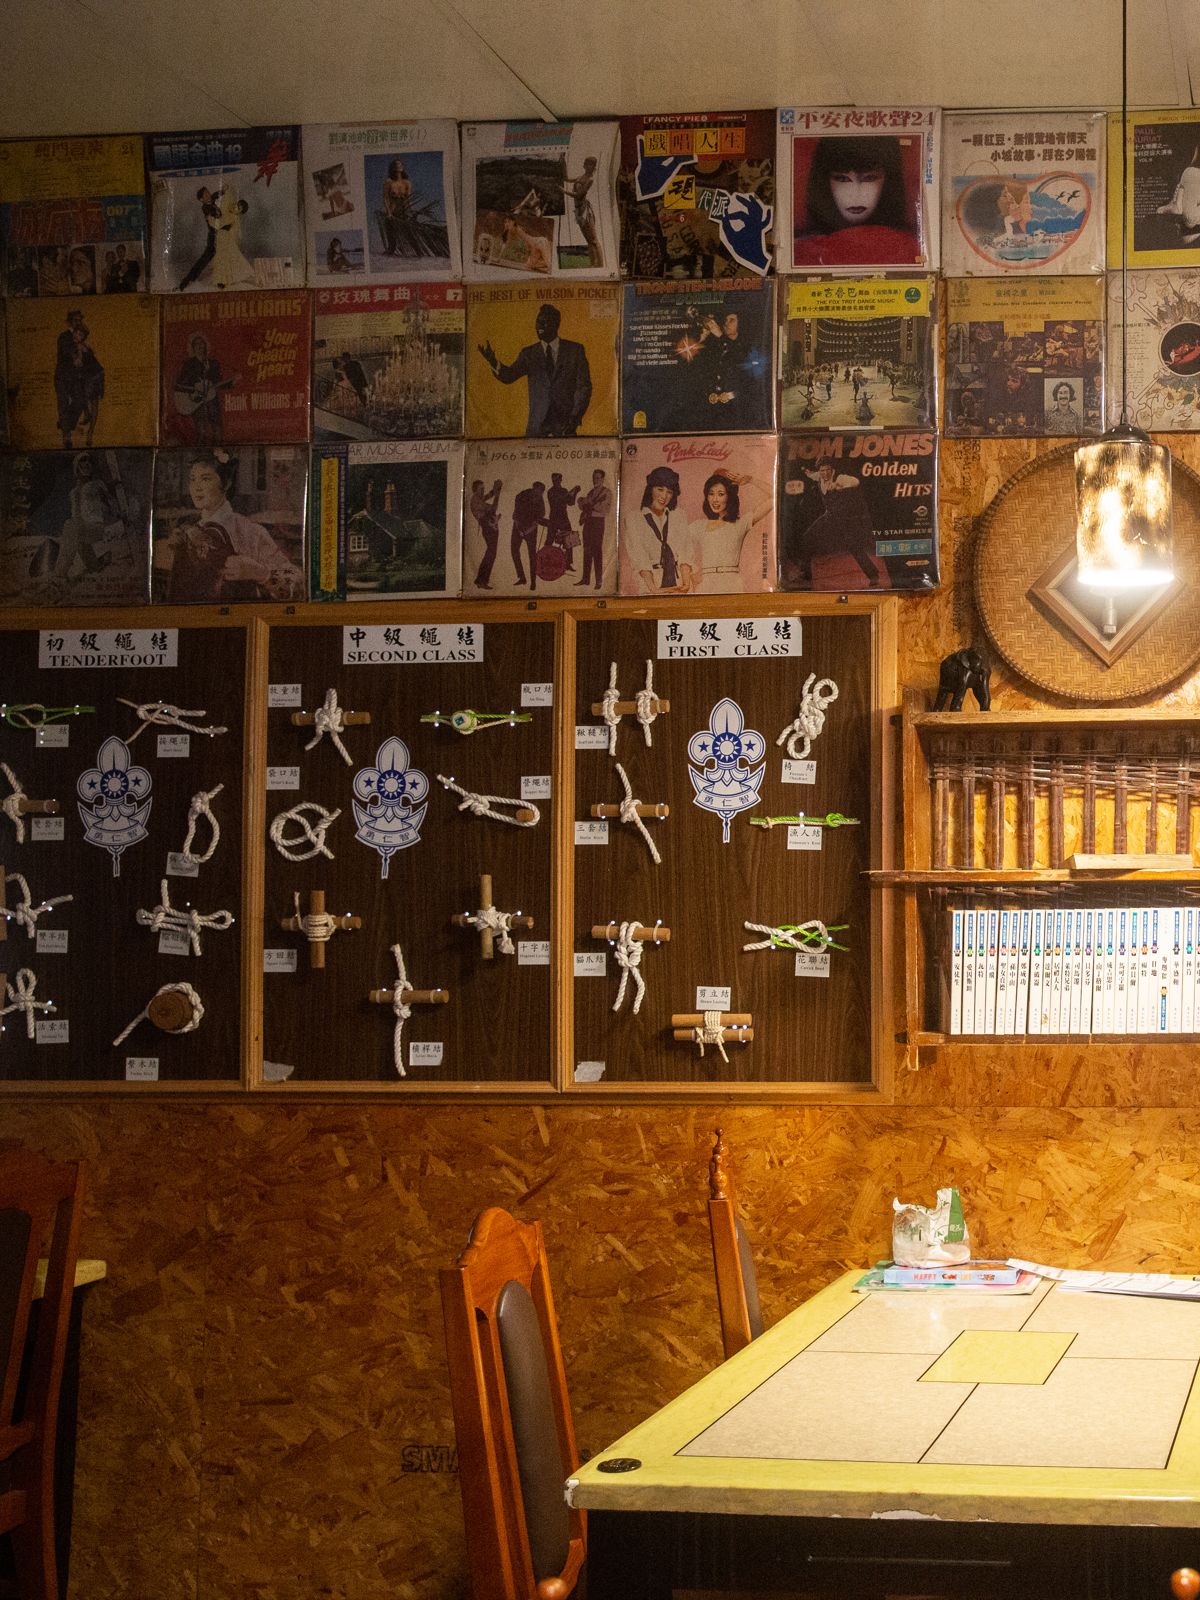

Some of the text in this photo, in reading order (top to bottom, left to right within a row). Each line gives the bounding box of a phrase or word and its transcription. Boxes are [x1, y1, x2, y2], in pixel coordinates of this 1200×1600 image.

[490, 289, 514, 301] BEST
[518, 289, 531, 300] OF
[536, 287, 574, 300] WILSON
[577, 286, 617, 299] PICKETT
[264, 328, 298, 348] Your
[366, 443, 405, 457] MUSIC
[663, 441, 733, 463] Pink Lady
[788, 433, 934, 460] TOM JONES
[491, 451, 517, 462] 1966
[862, 461, 918, 477] Golden
[894, 482, 933, 498] HITS
[349, 626, 475, 647] 中級繩結
[665, 619, 793, 642] 高級繩結
[46, 631, 169, 652] 初級繩結
[347, 649, 477, 663] SECOND CLASS
[668, 643, 790, 658] FIRST CLASS
[49, 653, 167, 667] TENDERFOOT
